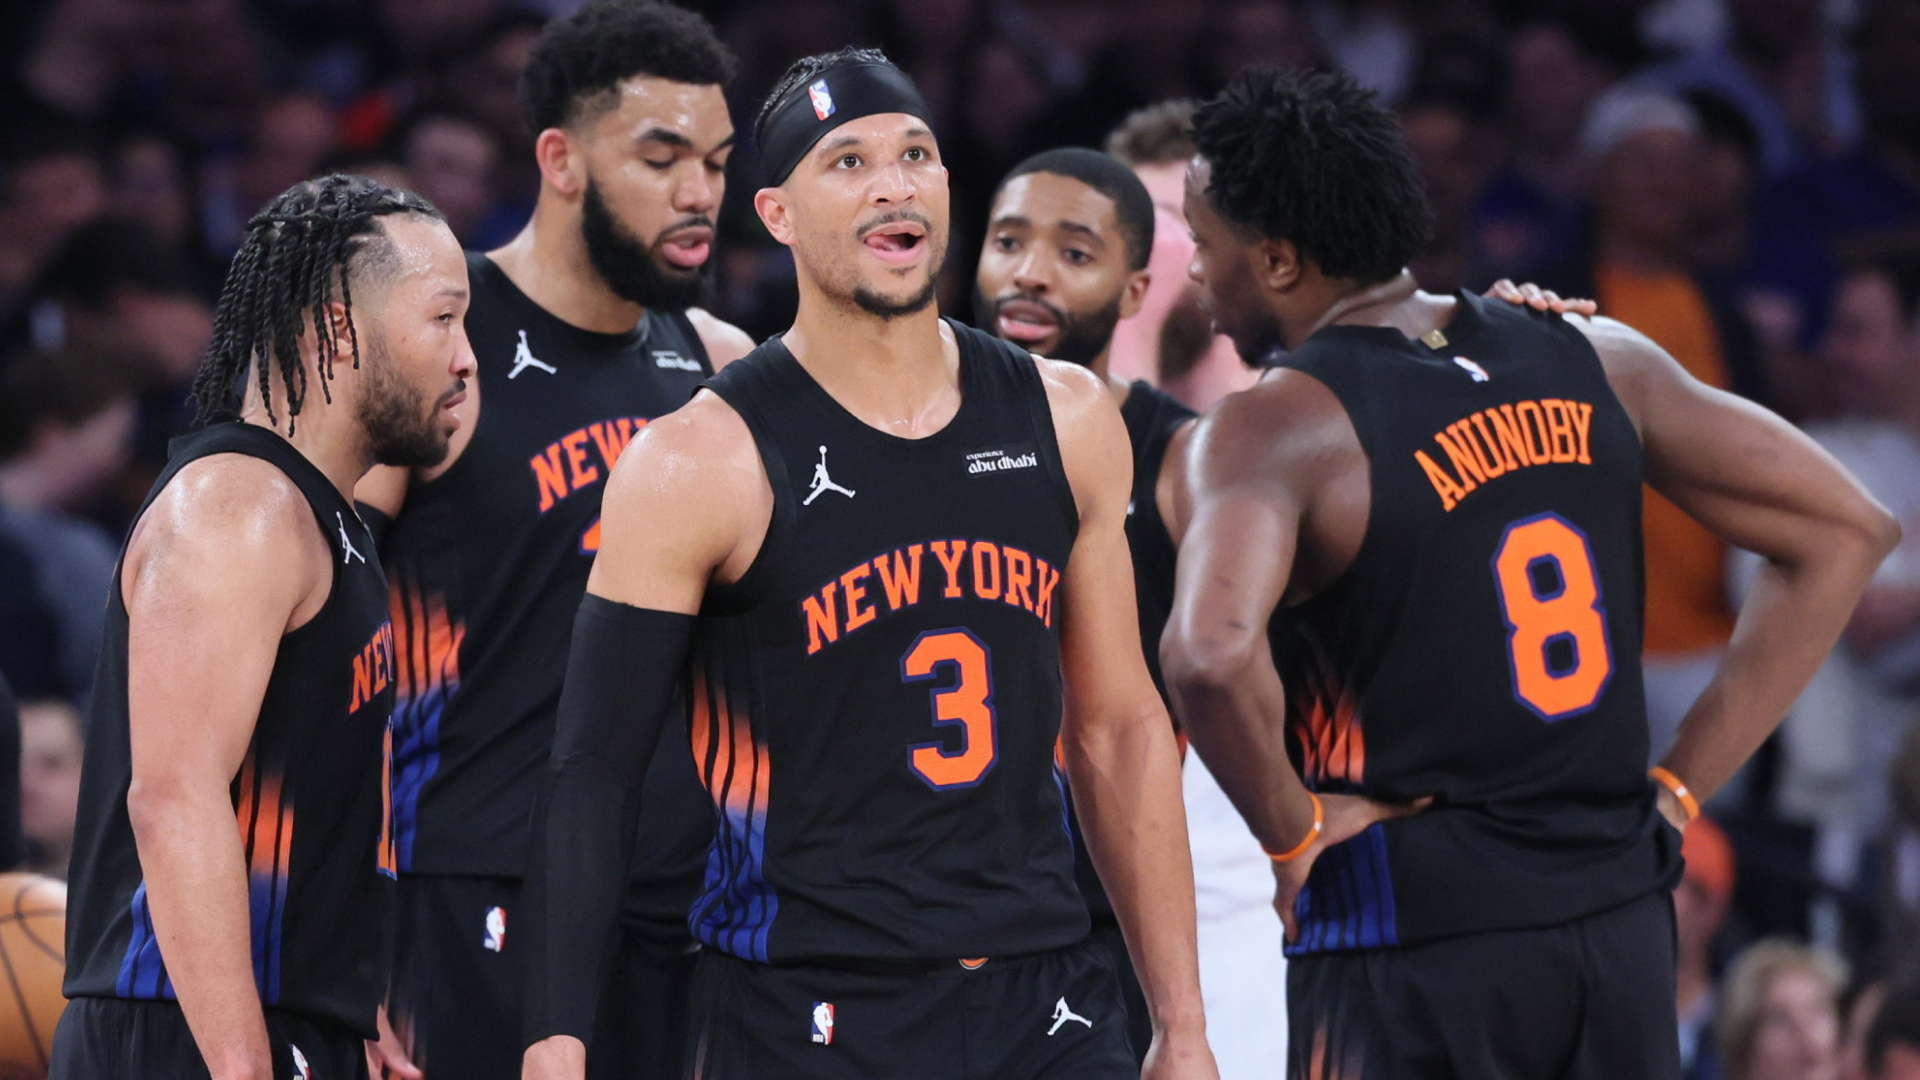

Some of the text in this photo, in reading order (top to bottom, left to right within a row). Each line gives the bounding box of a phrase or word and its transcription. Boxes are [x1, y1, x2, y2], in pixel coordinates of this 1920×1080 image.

[529, 417, 632, 514] NEW
[965, 450, 1004, 460] experience
[968, 452, 1038, 474] abu dhabi
[1414, 398, 1593, 512] ANUNOBY
[801, 538, 1060, 657] NEW YORK
[1489, 510, 1615, 723] 8
[899, 626, 999, 792] 3
